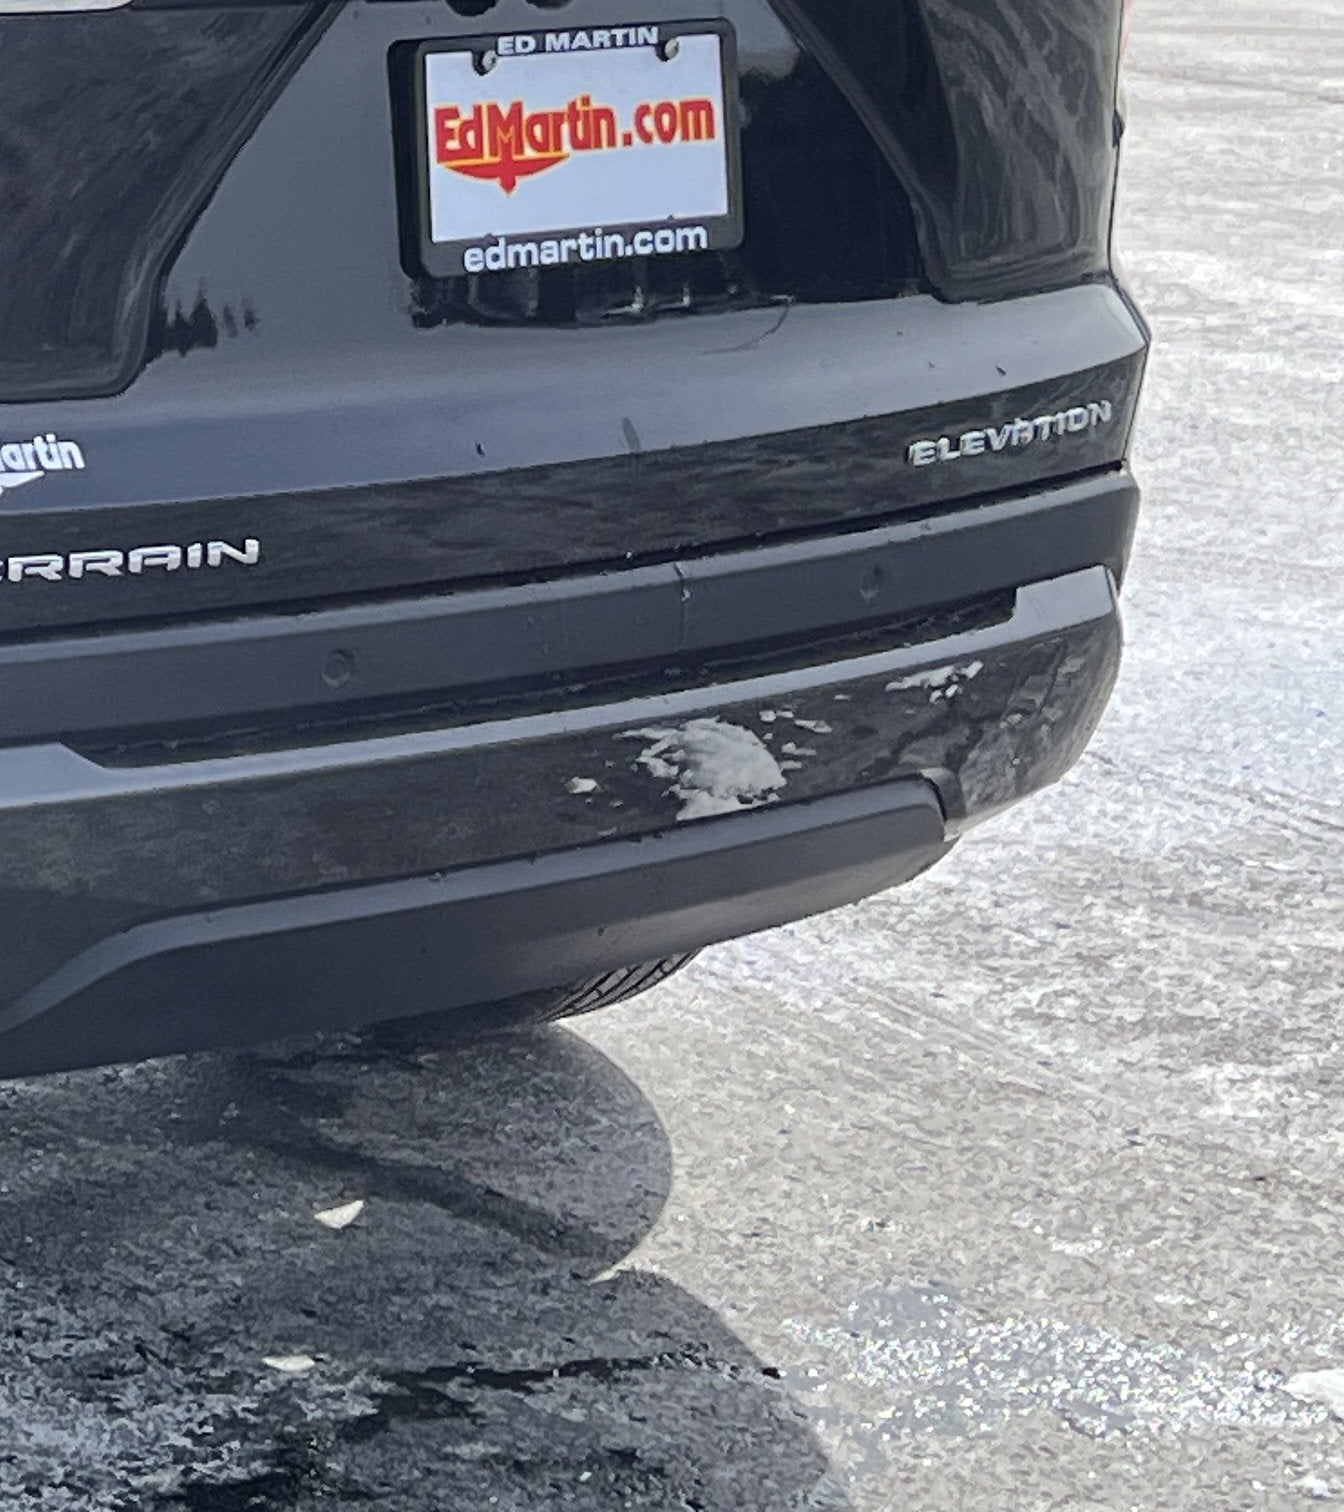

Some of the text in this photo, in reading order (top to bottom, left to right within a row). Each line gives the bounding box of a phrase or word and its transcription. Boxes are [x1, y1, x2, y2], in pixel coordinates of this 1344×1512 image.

[497, 27, 659, 56] ED MARTIN
[433, 95, 716, 163] EdMartin.com
[463, 223, 708, 273] edmartin.com
[908, 399, 1113, 467] ELEVATION
